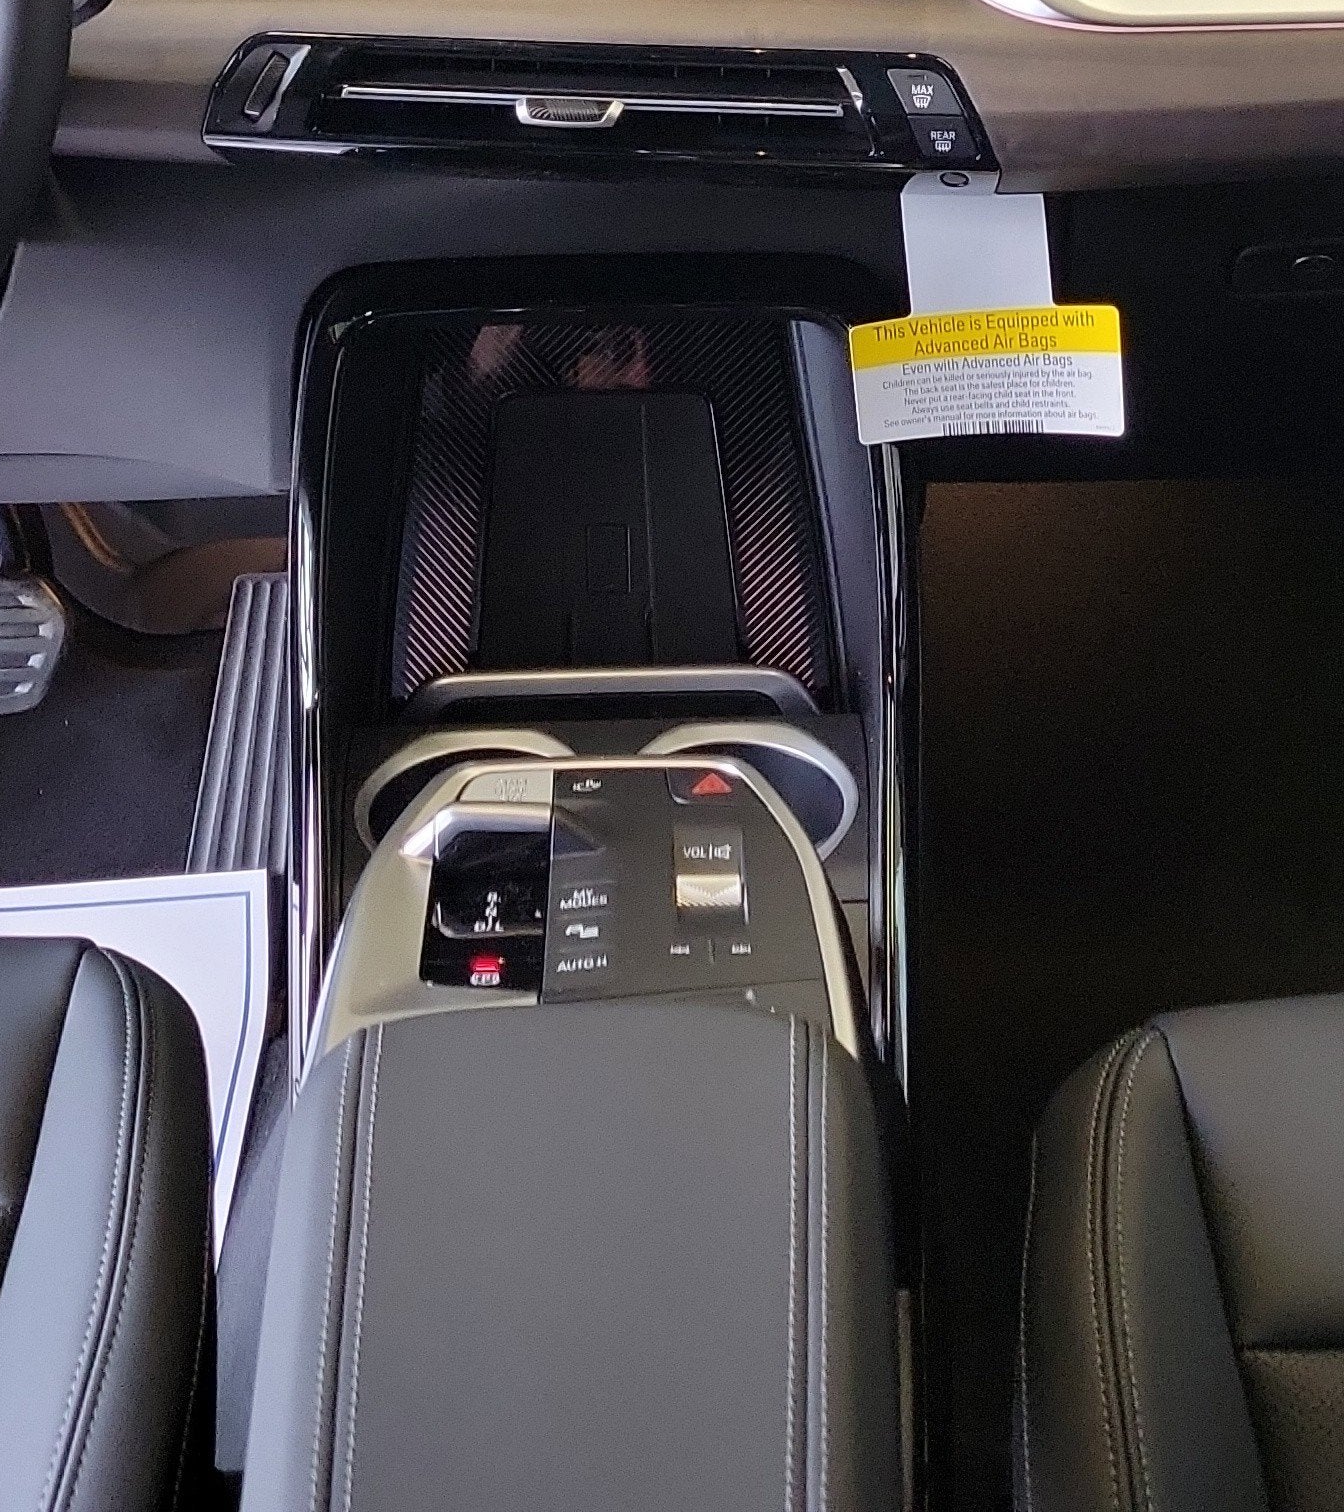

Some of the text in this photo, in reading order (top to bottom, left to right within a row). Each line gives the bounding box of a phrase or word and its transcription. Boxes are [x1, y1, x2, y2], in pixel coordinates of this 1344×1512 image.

[911, 84, 934, 96] MAX
[930, 130, 956, 141] REAR
[873, 308, 1095, 342] This Vehicle is Equipped with
[914, 332, 1058, 357] Advanced Air Bags
[902, 353, 1073, 376] Even with Advanced Air Bags
[882, 377, 916, 390] Children
[917, 376, 932, 385] can
[944, 372, 965, 383] killed
[966, 373, 975, 381] or
[976, 369, 1011, 381] seriously
[1012, 368, 1041, 380] injured
[1041, 369, 1051, 380] by
[1052, 368, 1065, 378] the
[1066, 368, 1076, 378] air
[904, 387, 919, 397] The
[920, 384, 939, 395] back
[940, 383, 958, 393] seat
[967, 381, 980, 391] the
[981, 380, 1006, 390] safest
[1006, 379, 1028, 390] place
[1029, 379, 1040, 388] for
[904, 395, 927, 406] Never
[928, 393, 943, 404] put
[994, 388, 1013, 399] child
[1014, 389, 1031, 398] seat
[1041, 388, 1055, 397] the
[995, 399, 1010, 408] and
[1011, 398, 1030, 408] child
[884, 418, 900, 428] See
[933, 411, 962, 423] manual
[963, 410, 975, 420] for
[975, 410, 996, 420] more
[997, 409, 1043, 419] information
[1043, 408, 1067, 418] about
[683, 845, 708, 859] VOL
